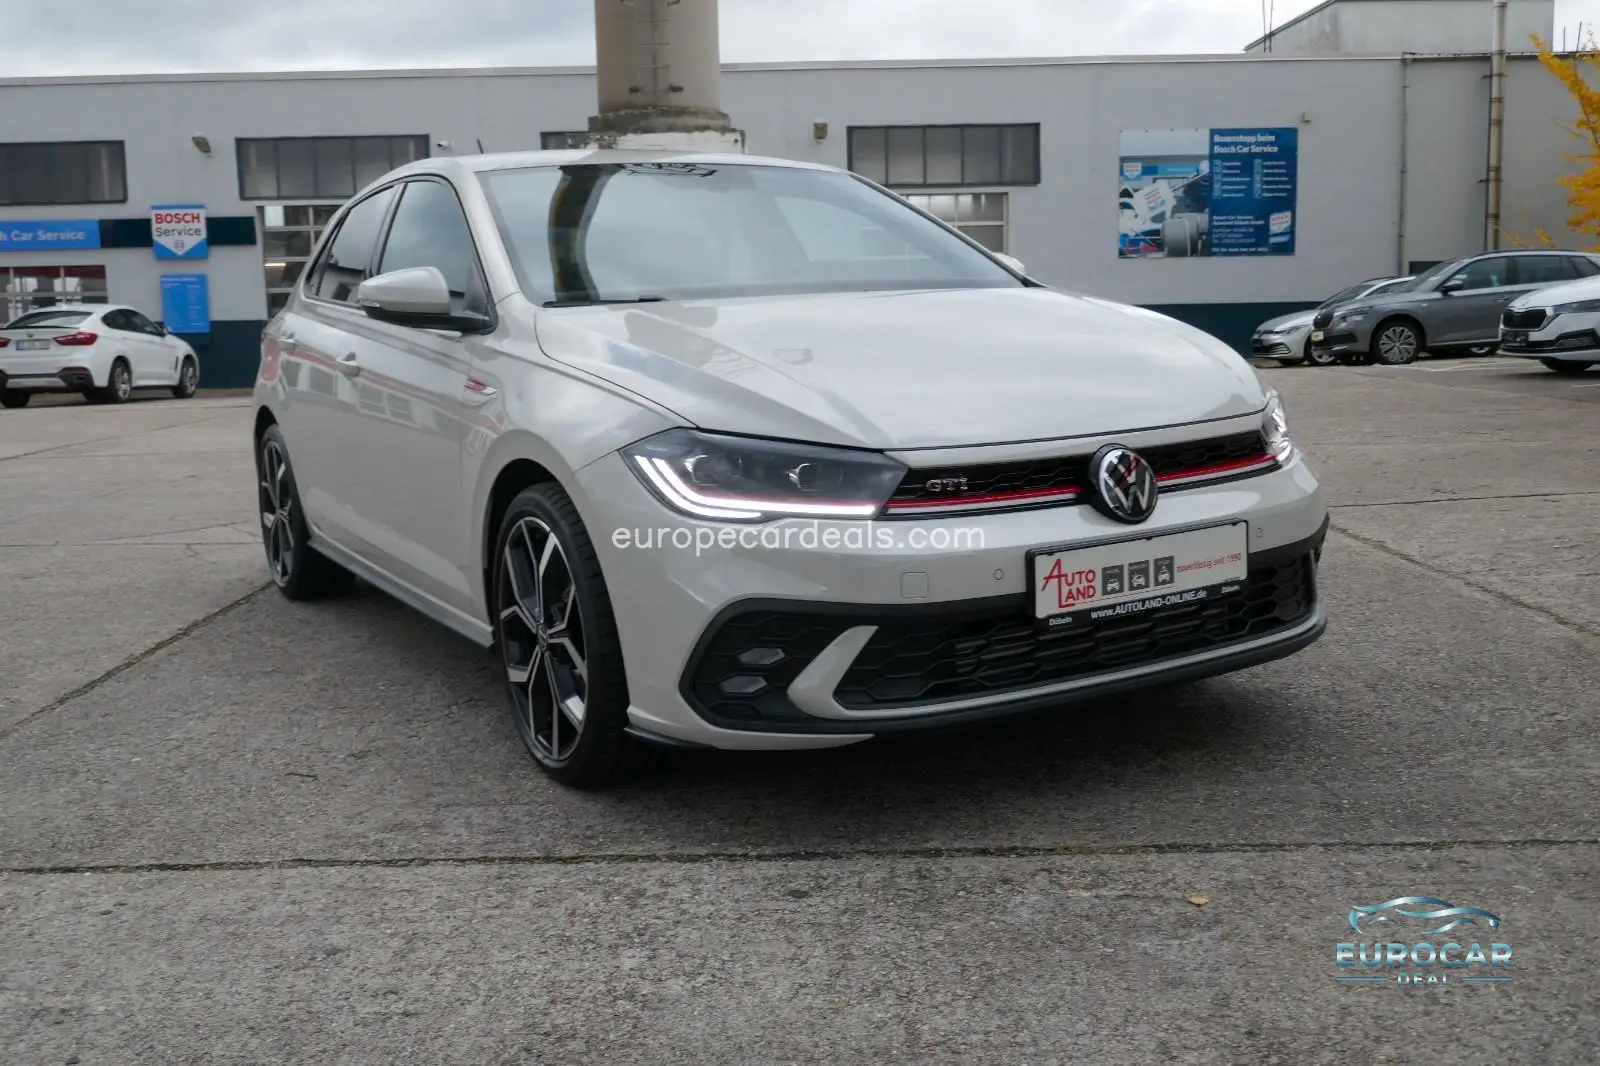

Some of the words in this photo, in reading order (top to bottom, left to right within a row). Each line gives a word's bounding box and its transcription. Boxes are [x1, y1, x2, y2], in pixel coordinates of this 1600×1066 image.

[1251, 145, 1278, 153] Service
[155, 212, 200, 224] BOSCH
[12, 230, 32, 241] Car
[37, 229, 85, 240] Service
[155, 225, 202, 237] Service
[925, 477, 969, 492] GTI
[1041, 558, 1097, 592] AUTO
[1058, 585, 1097, 609] LAND
[1090, 590, 1207, 619] www.AUTOLAND-ONLINE.de
